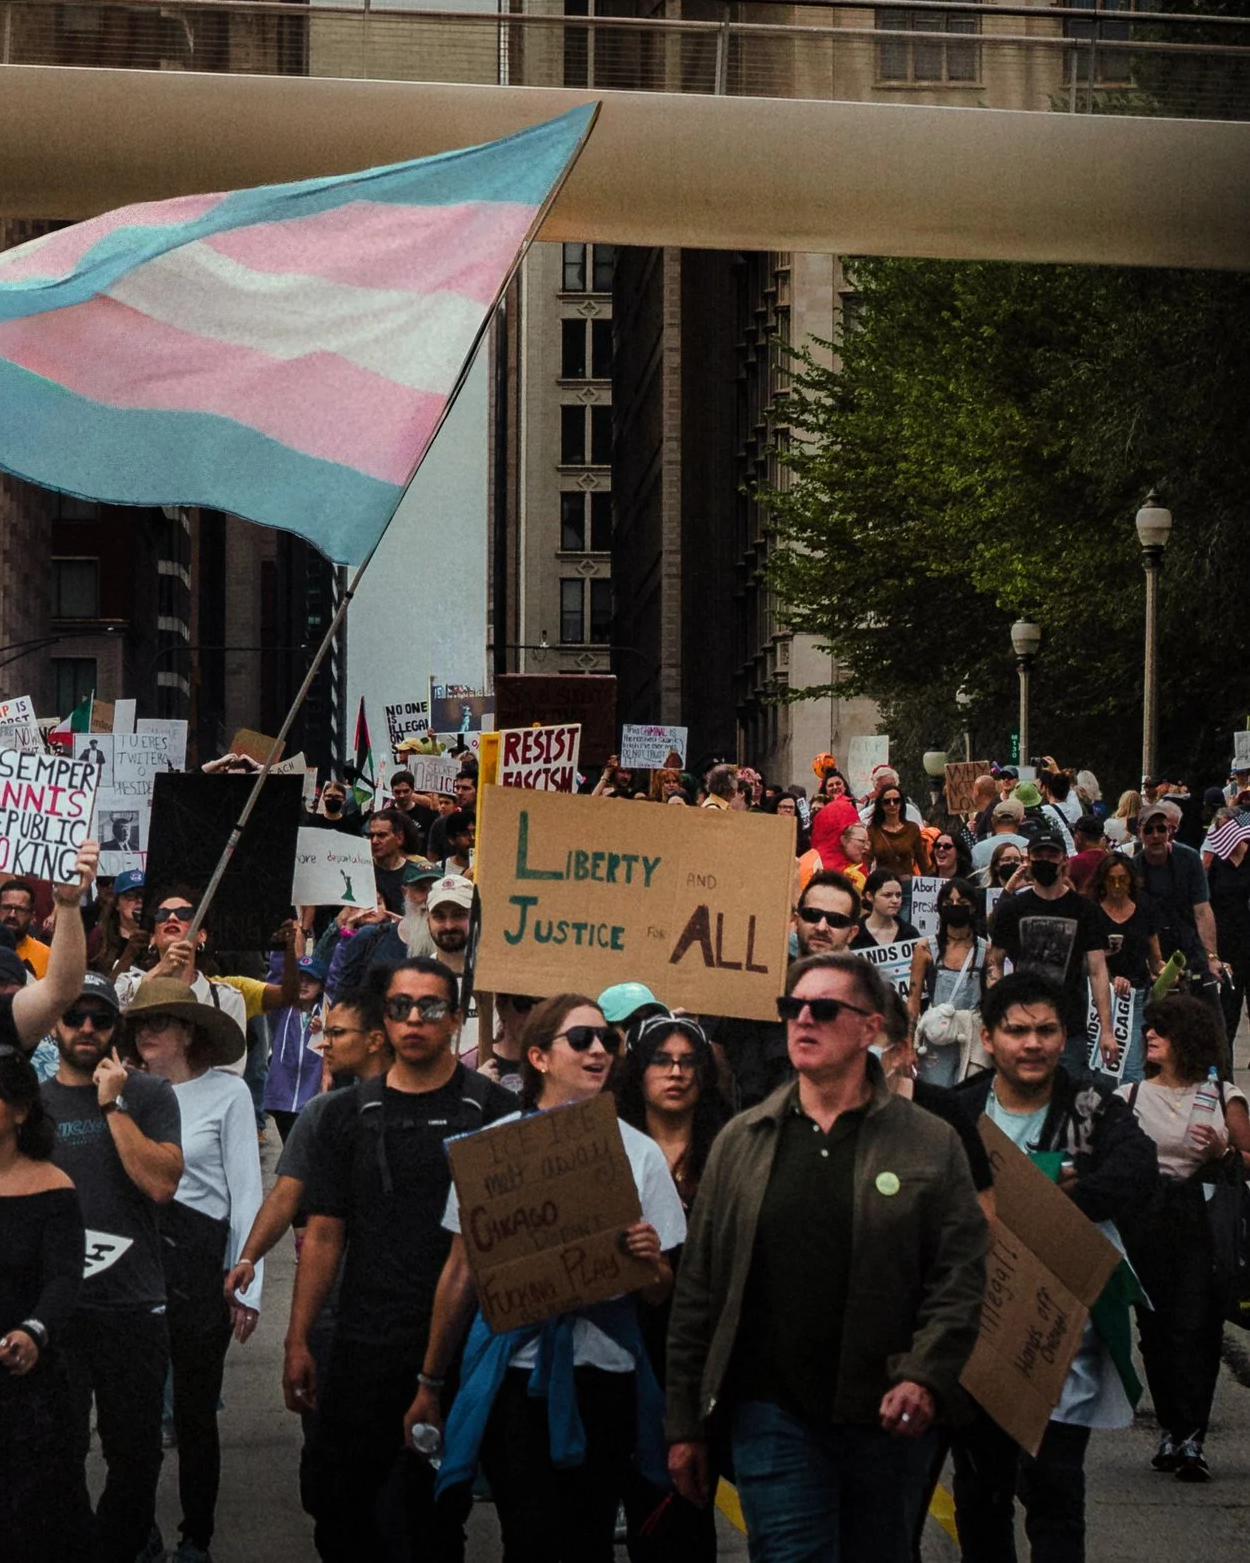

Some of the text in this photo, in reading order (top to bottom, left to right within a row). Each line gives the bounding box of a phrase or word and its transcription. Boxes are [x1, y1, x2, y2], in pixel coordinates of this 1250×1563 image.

[15, 700, 27, 713] IS
[386, 701, 427, 716] NO ONE
[142, 735, 168, 750] ERES
[503, 727, 579, 767] RESIST
[502, 766, 574, 794] FASCISM
[946, 763, 988, 780] WHY
[113, 781, 153, 796] PRESIDE
[949, 794, 978, 812] LOV
[12, 838, 81, 882] KING
[516, 811, 718, 890] LIBERTY AND
[913, 878, 937, 893] Abort
[504, 895, 625, 951] JUSTICE
[668, 903, 769, 974] ALL
[857, 941, 918, 964] ANDS OF
[1086, 1011, 1100, 1056] ANDS
[560, 1247, 622, 1291] PLAY
